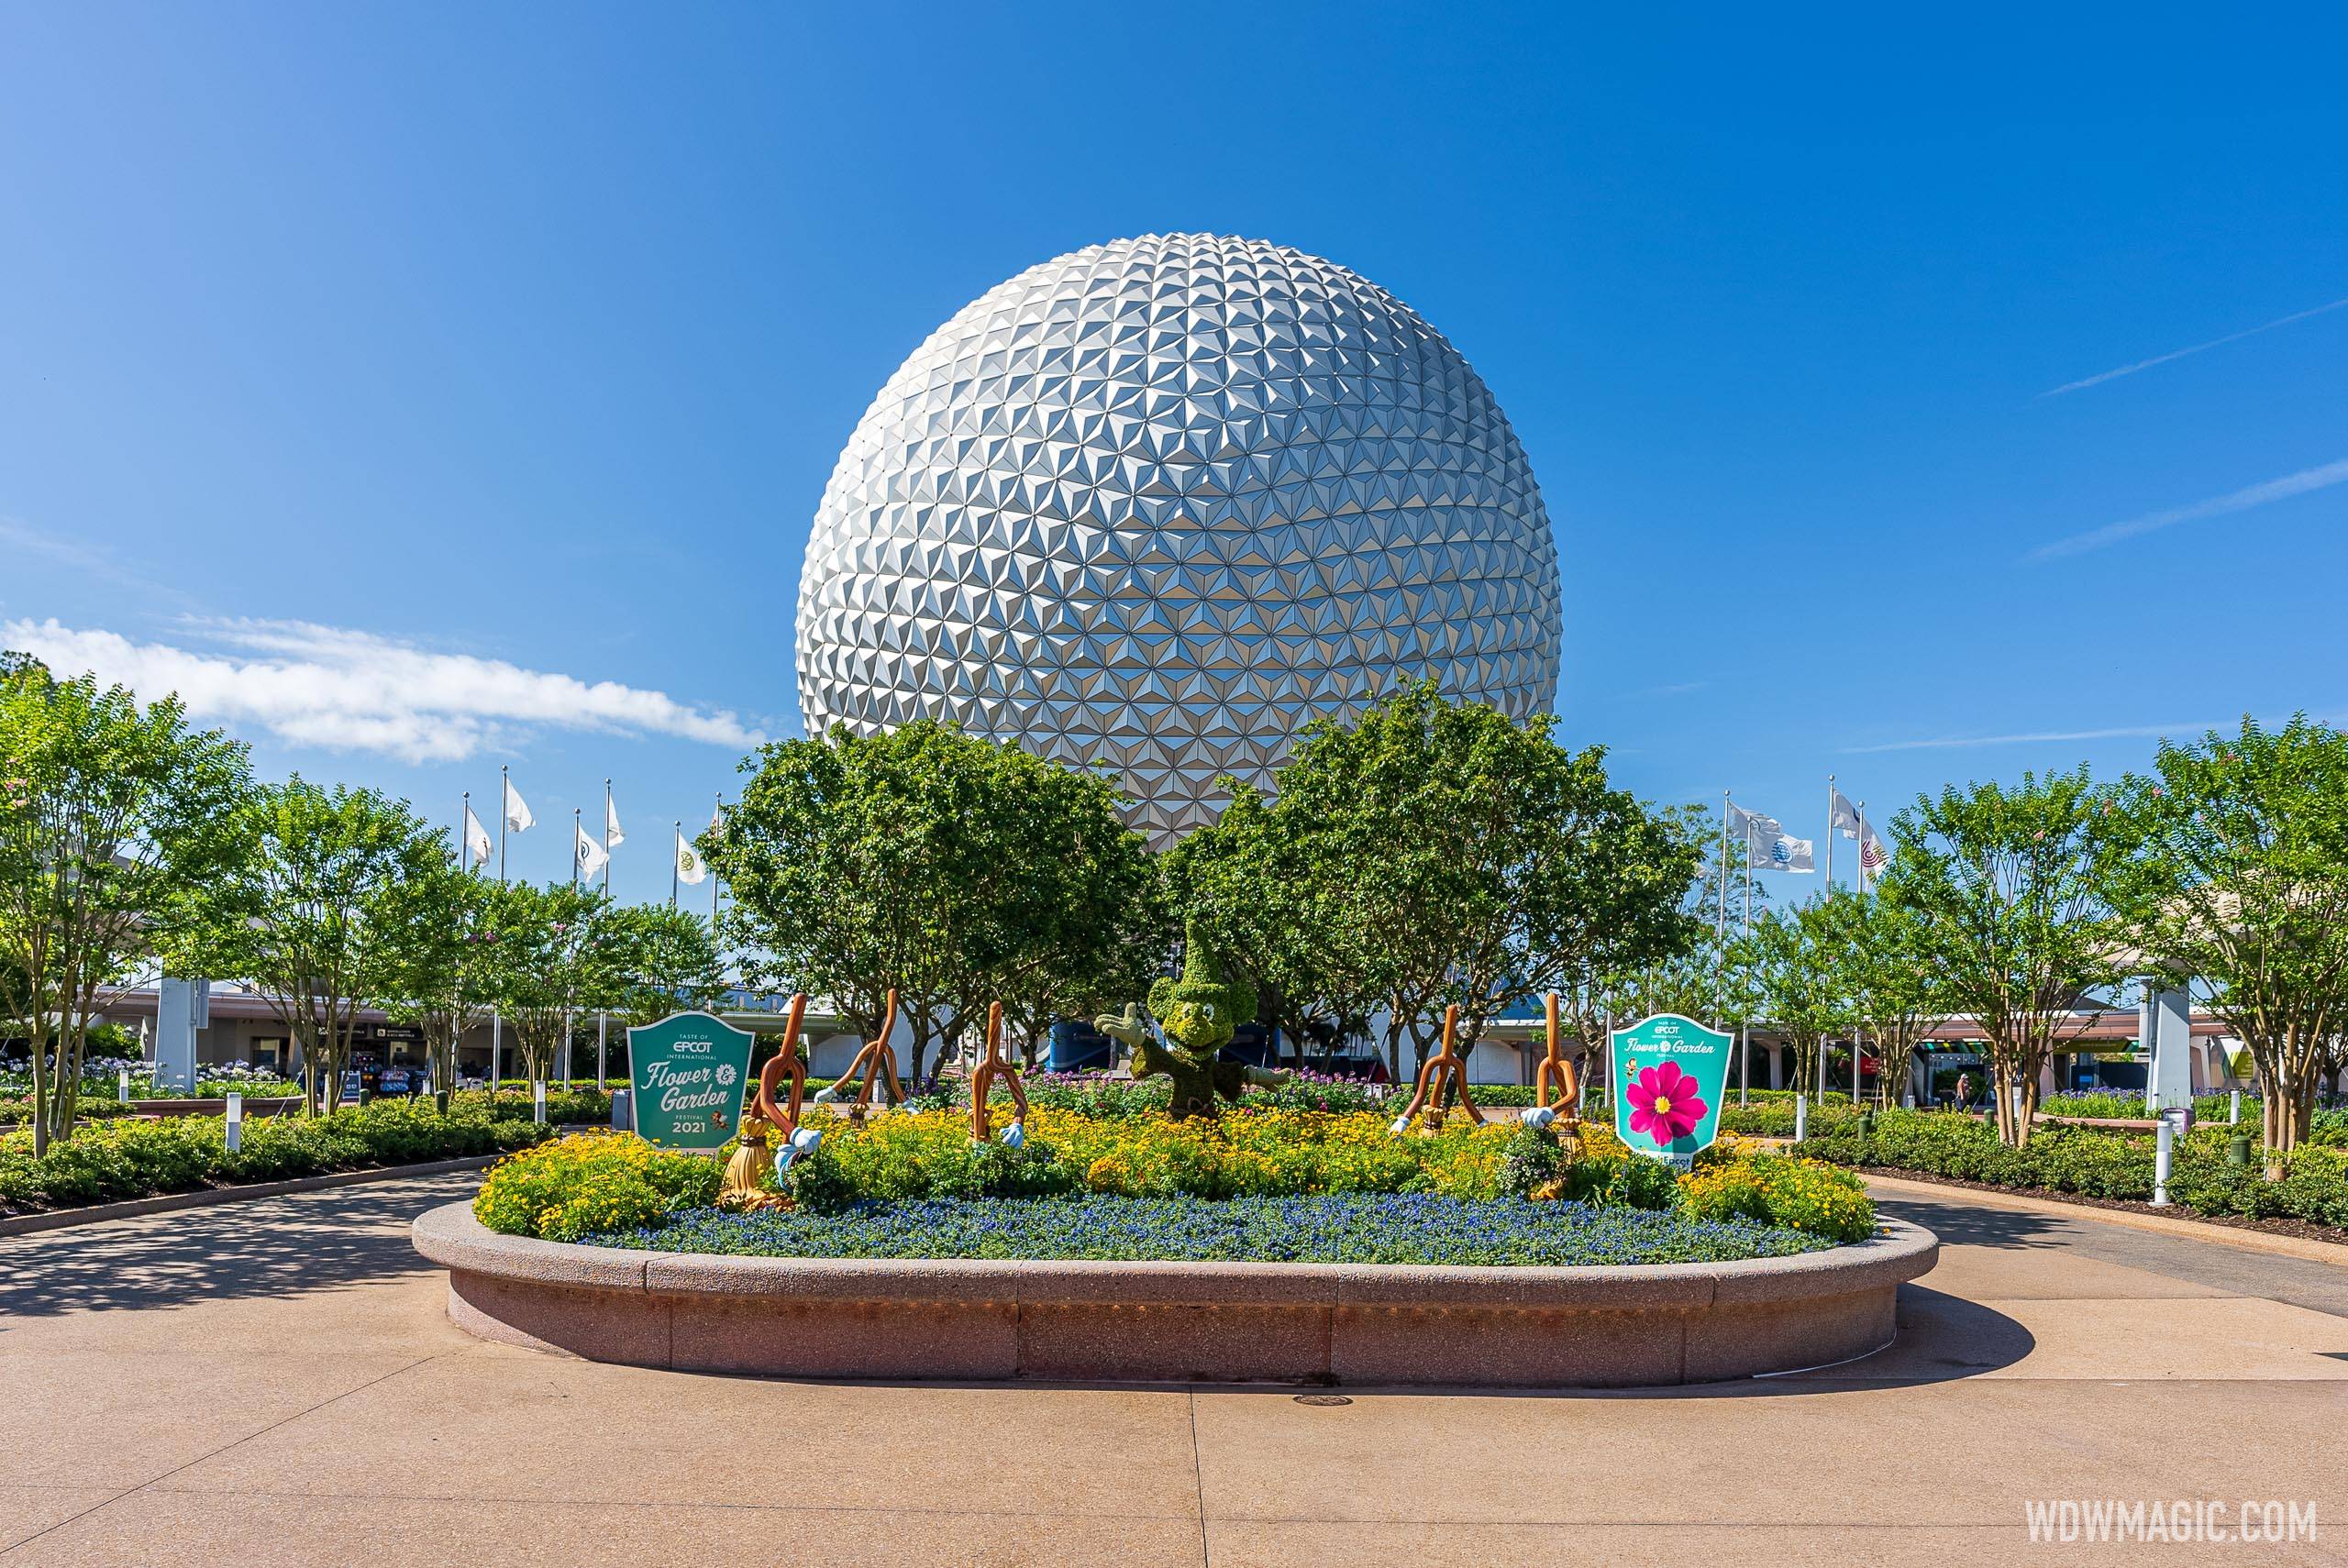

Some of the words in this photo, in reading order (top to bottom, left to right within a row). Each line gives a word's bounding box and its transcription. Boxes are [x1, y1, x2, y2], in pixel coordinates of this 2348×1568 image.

[1654, 1026, 1680, 1034] EPCOT
[673, 1042, 713, 1053] EPCOT
[1624, 1038, 1659, 1053] Flower
[1672, 1040, 1716, 1055] Garden
[641, 1061, 713, 1090] Flower
[660, 1083, 730, 1112] Garden
[672, 1121, 705, 1133] 2021
[1664, 1155, 1690, 1166] Epcot
